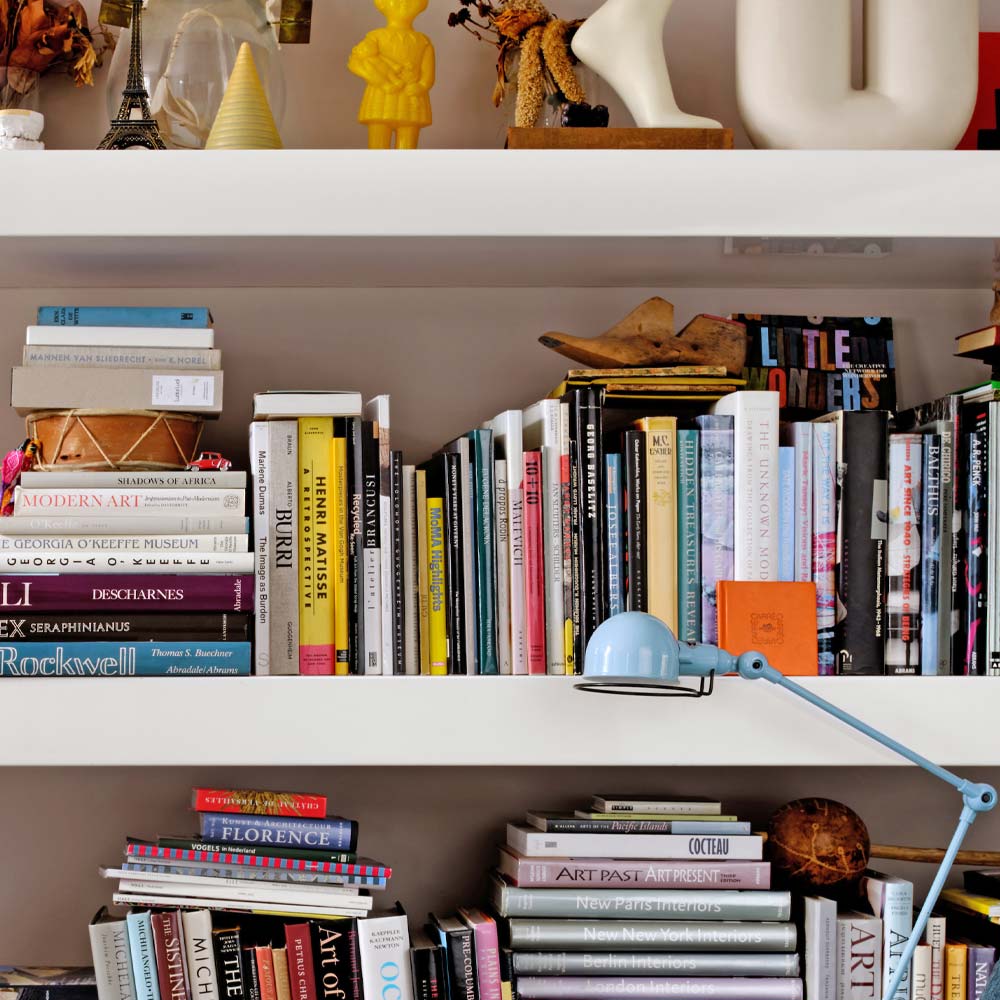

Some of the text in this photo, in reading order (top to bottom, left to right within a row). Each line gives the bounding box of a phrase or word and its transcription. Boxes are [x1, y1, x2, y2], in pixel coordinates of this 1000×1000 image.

[761, 327, 850, 371] LITTLE
[587, 424, 596, 519] GEORG BASELITZ
[942, 432, 951, 483] DE CHIRICO
[972, 460, 981, 486] PENCK
[118, 477, 216, 485] SHADOWS OF AFRICA
[258, 451, 267, 515] Marlene Dumas
[525, 461, 540, 505] 10+10
[903, 465, 912, 485] ART
[927, 446, 939, 516] BALTHUS
[23, 494, 102, 508] MODERN
[107, 494, 144, 508] ART
[352, 494, 362, 535] Recycled
[366, 474, 375, 548] BRANCUSI
[685, 440, 696, 585] HIDDEN TREASURES
[14, 539, 198, 549] GEORGIA MUSEUM
[275, 508, 293, 569] BURRI
[303, 487, 311, 609] RETROSPECTIVE
[316, 476, 327, 600] HENRI MATISSE
[512, 499, 523, 566] MALEVICH
[430, 508, 443, 612] MoMA Highlights
[92, 589, 184, 600] DESCHARNES
[234, 578, 242, 612] Abradale
[258, 536, 267, 624] The Image as Burden
[30, 622, 130, 633] SERAPHINIANUS
[152, 648, 232, 657] Thomas S. Buechner
[221, 827, 330, 846] FLORENCE
[611, 821, 668, 832] Pacific Islands
[191, 843, 220, 852] VOGELS
[229, 846, 256, 854] Nederland
[688, 838, 729, 855] COCTEAU
[556, 867, 643, 882] ART PAST
[576, 896, 722, 913] New Paris Interiors
[162, 918, 172, 937] THE
[583, 927, 762, 944] New New York Interiors
[294, 938, 305, 976] PETRUS
[318, 926, 342, 966] Art
[583, 954, 697, 969] Berlin Interiors
[850, 925, 875, 997] ART
[223, 956, 244, 997] THE
[488, 947, 500, 984] PLAINS
[323, 972, 346, 1000] of
[430, 978, 438, 998] THE
[650, 981, 715, 994] Interiors
